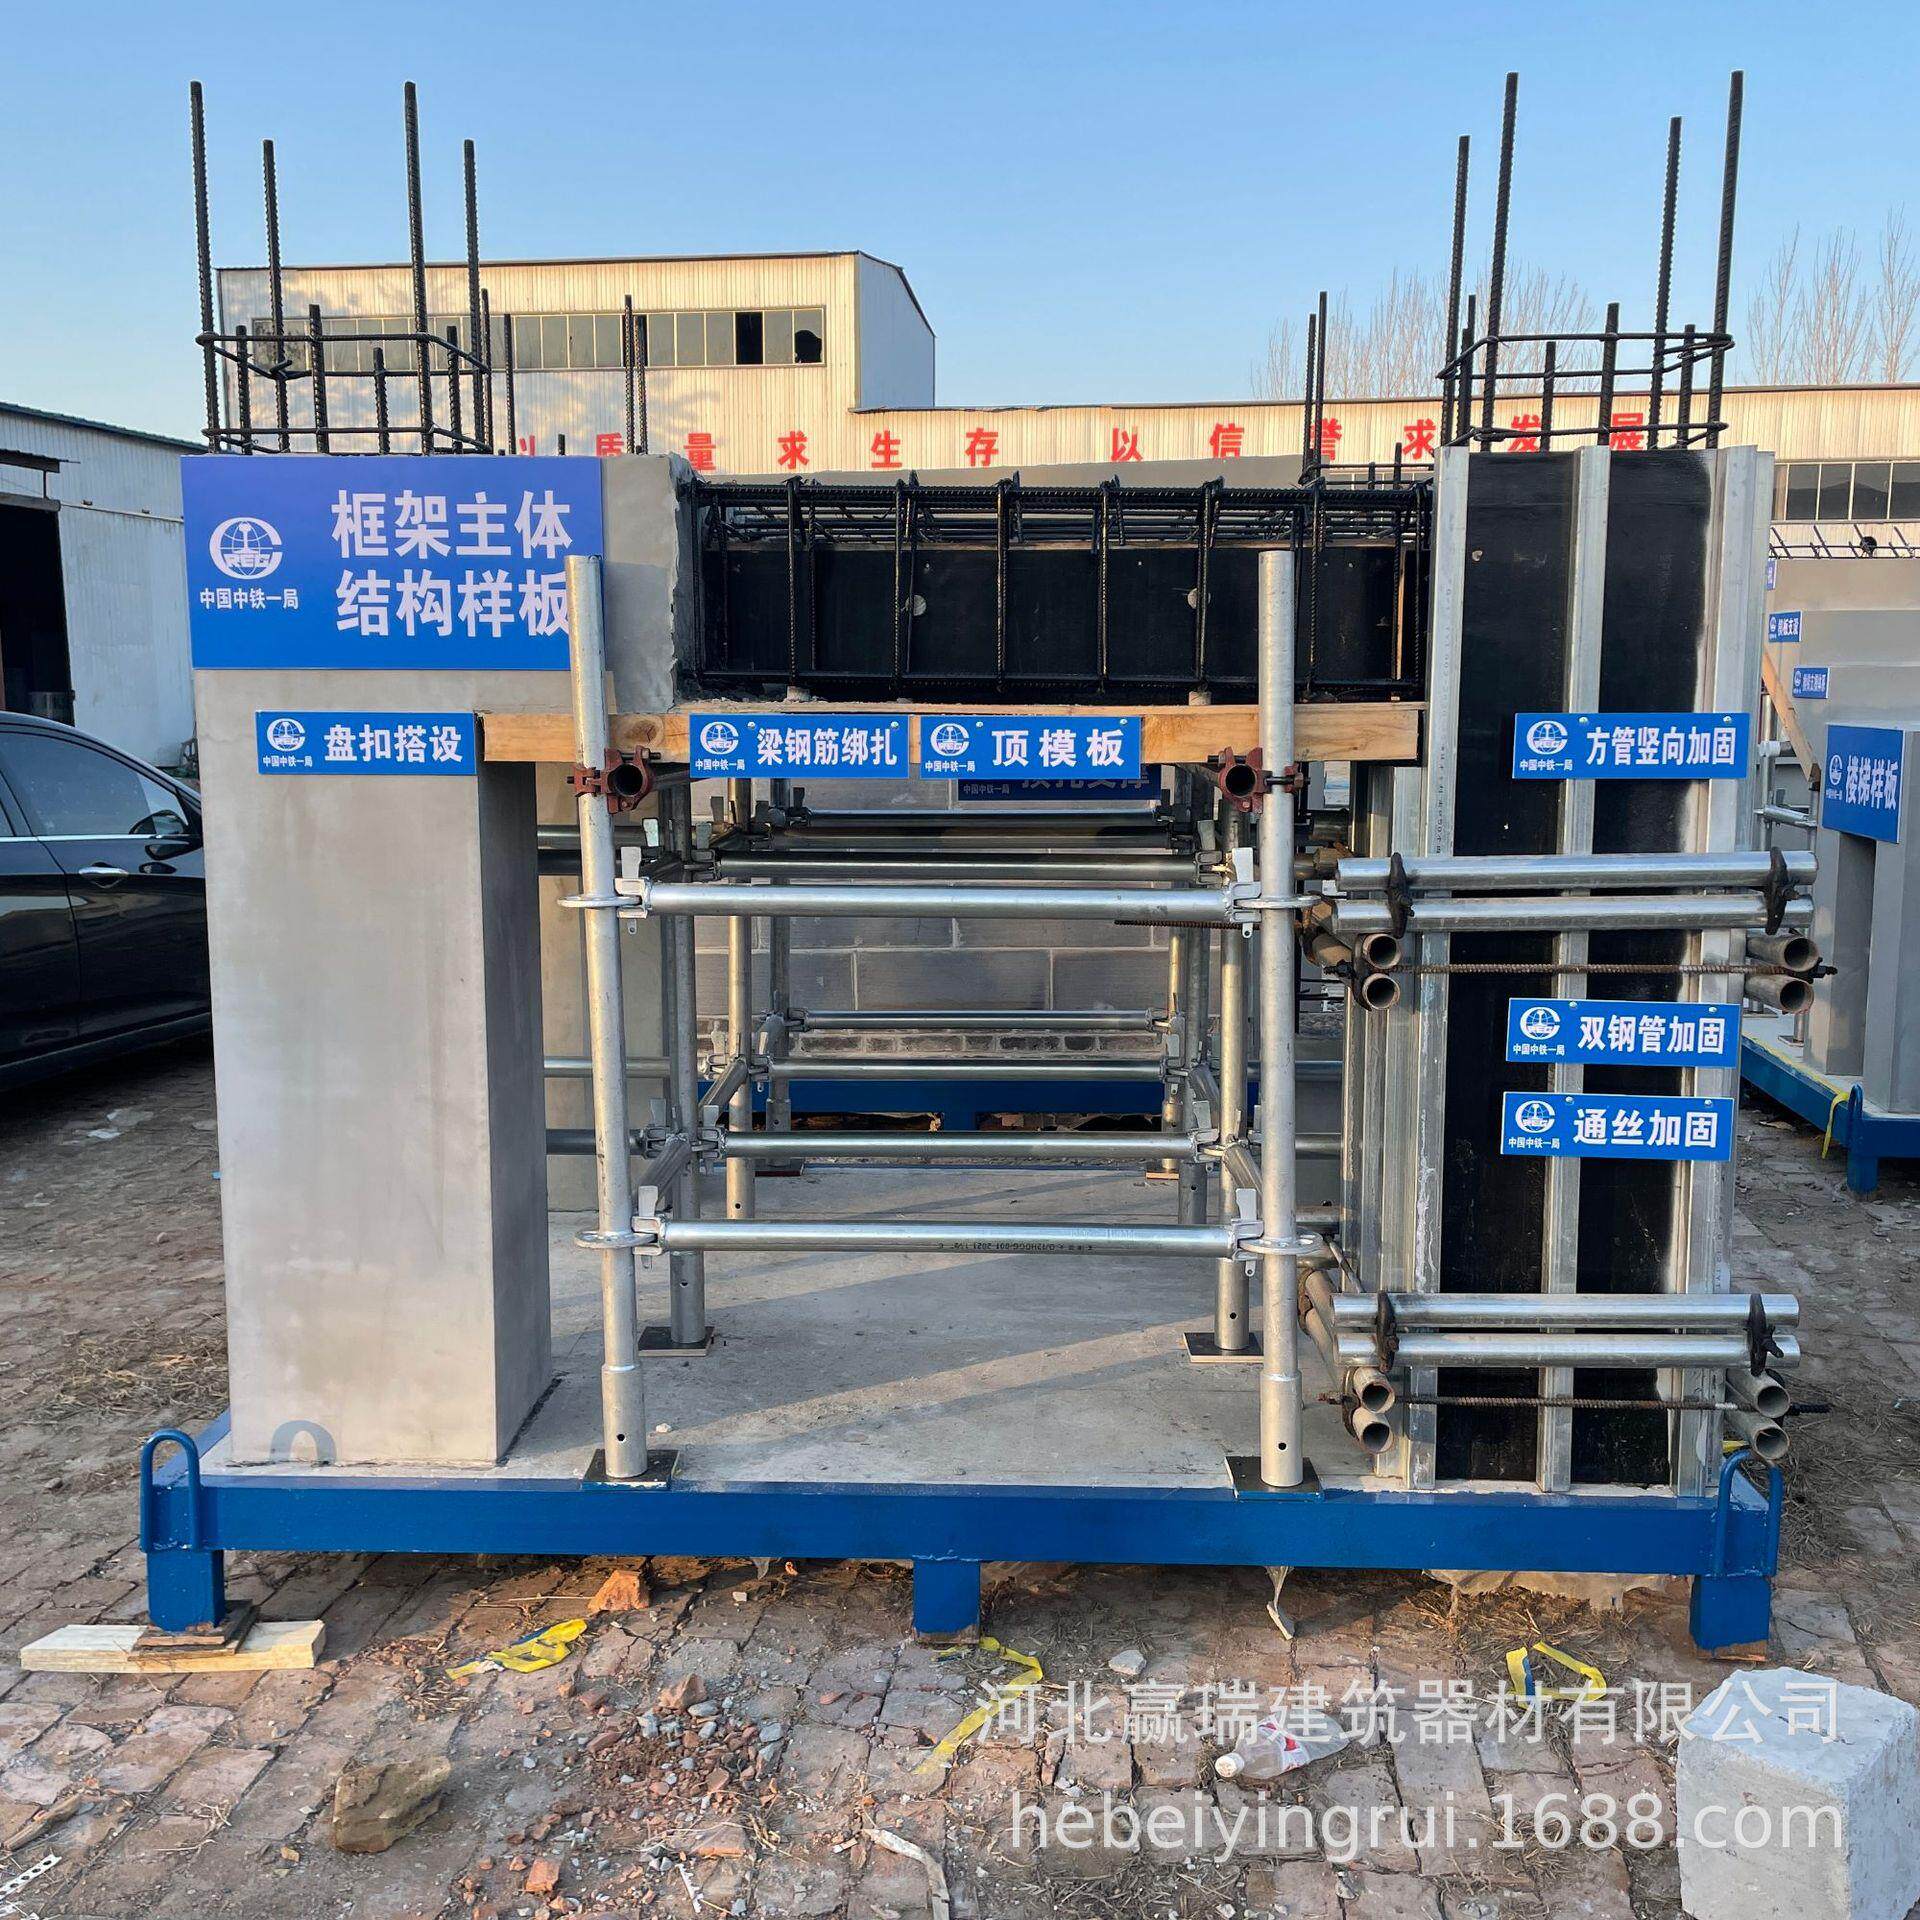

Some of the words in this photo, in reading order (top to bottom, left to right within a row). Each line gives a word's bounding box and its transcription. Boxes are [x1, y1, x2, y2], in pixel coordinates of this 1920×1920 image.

[332, 489, 573, 560] 框架主体
[200, 587, 299, 610] 中国中铁一局
[336, 569, 570, 638] 结构样板
[262, 755, 313, 767] 中国中铁一局
[324, 724, 463, 763] 盘扣搭设
[757, 727, 897, 766] 梁钢筋绑扎
[991, 728, 1125, 767] 顶模板
[1586, 726, 1737, 766] 方管竖向加固
[695, 759, 746, 771] 中国中铁一局
[925, 760, 976, 772] 中国中铁一局
[1519, 759, 1573, 771] 中国中铁一局
[1846, 755, 1899, 810] 楼梯样板
[1513, 1043, 1565, 1056] 中国中铁一局
[1577, 1014, 1726, 1054] 双钢管加固
[1508, 1136, 1560, 1149] 中国中铁一局
[1573, 1108, 1718, 1148] 通丝加固
